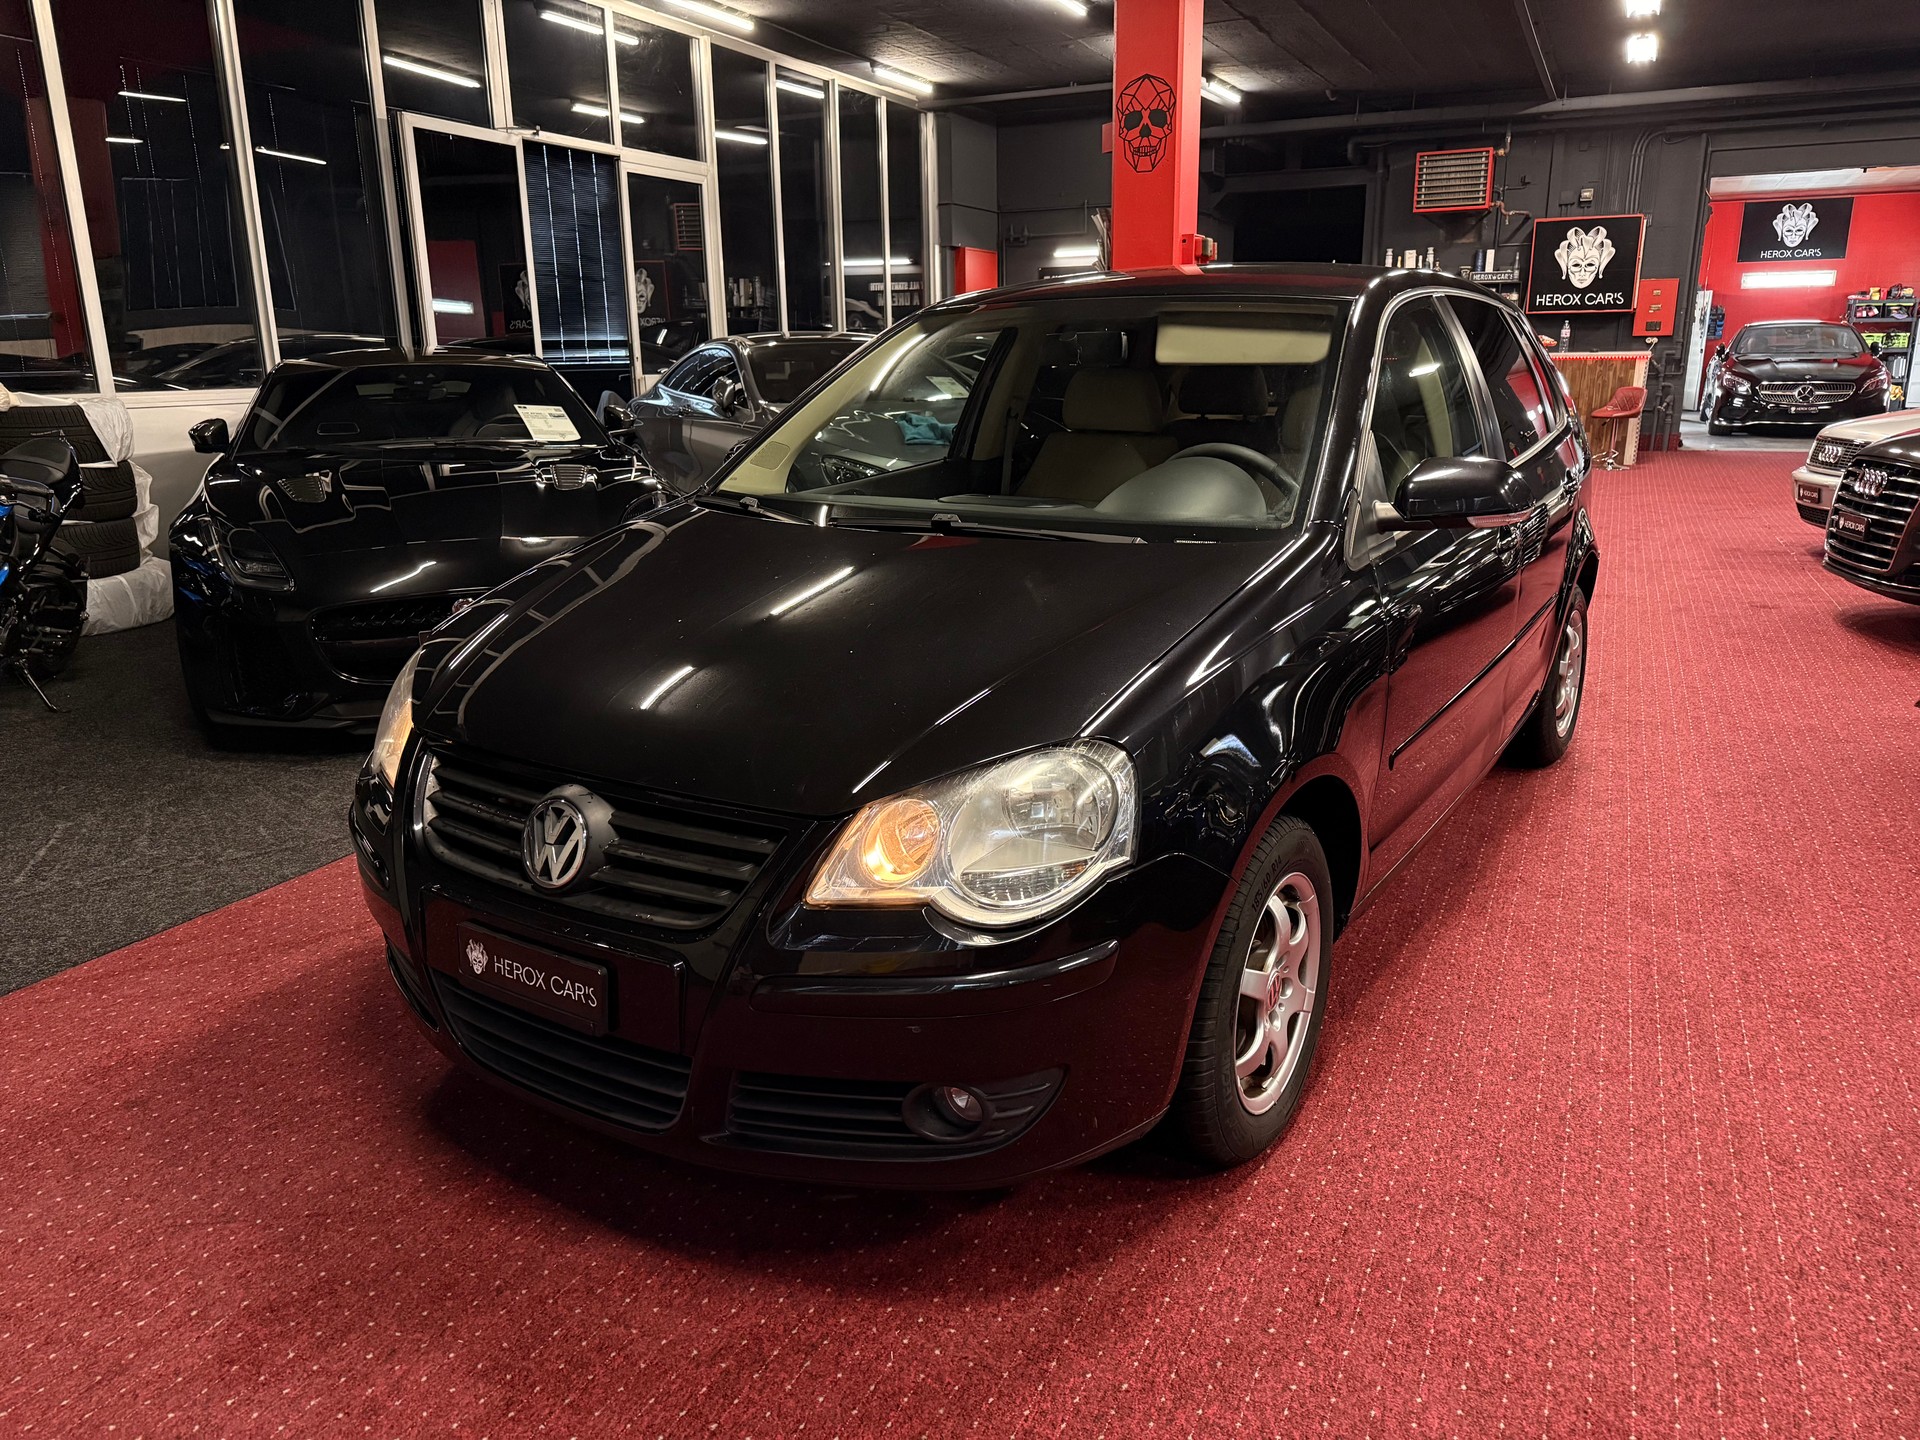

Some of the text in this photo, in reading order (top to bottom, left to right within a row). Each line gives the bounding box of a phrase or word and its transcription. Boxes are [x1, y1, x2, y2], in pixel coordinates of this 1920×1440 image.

[1760, 248, 1822, 259] HEROX CAR'S
[1536, 292, 1624, 306] HEROX CAR'S
[494, 955, 598, 1008] HEROX CAR'S
